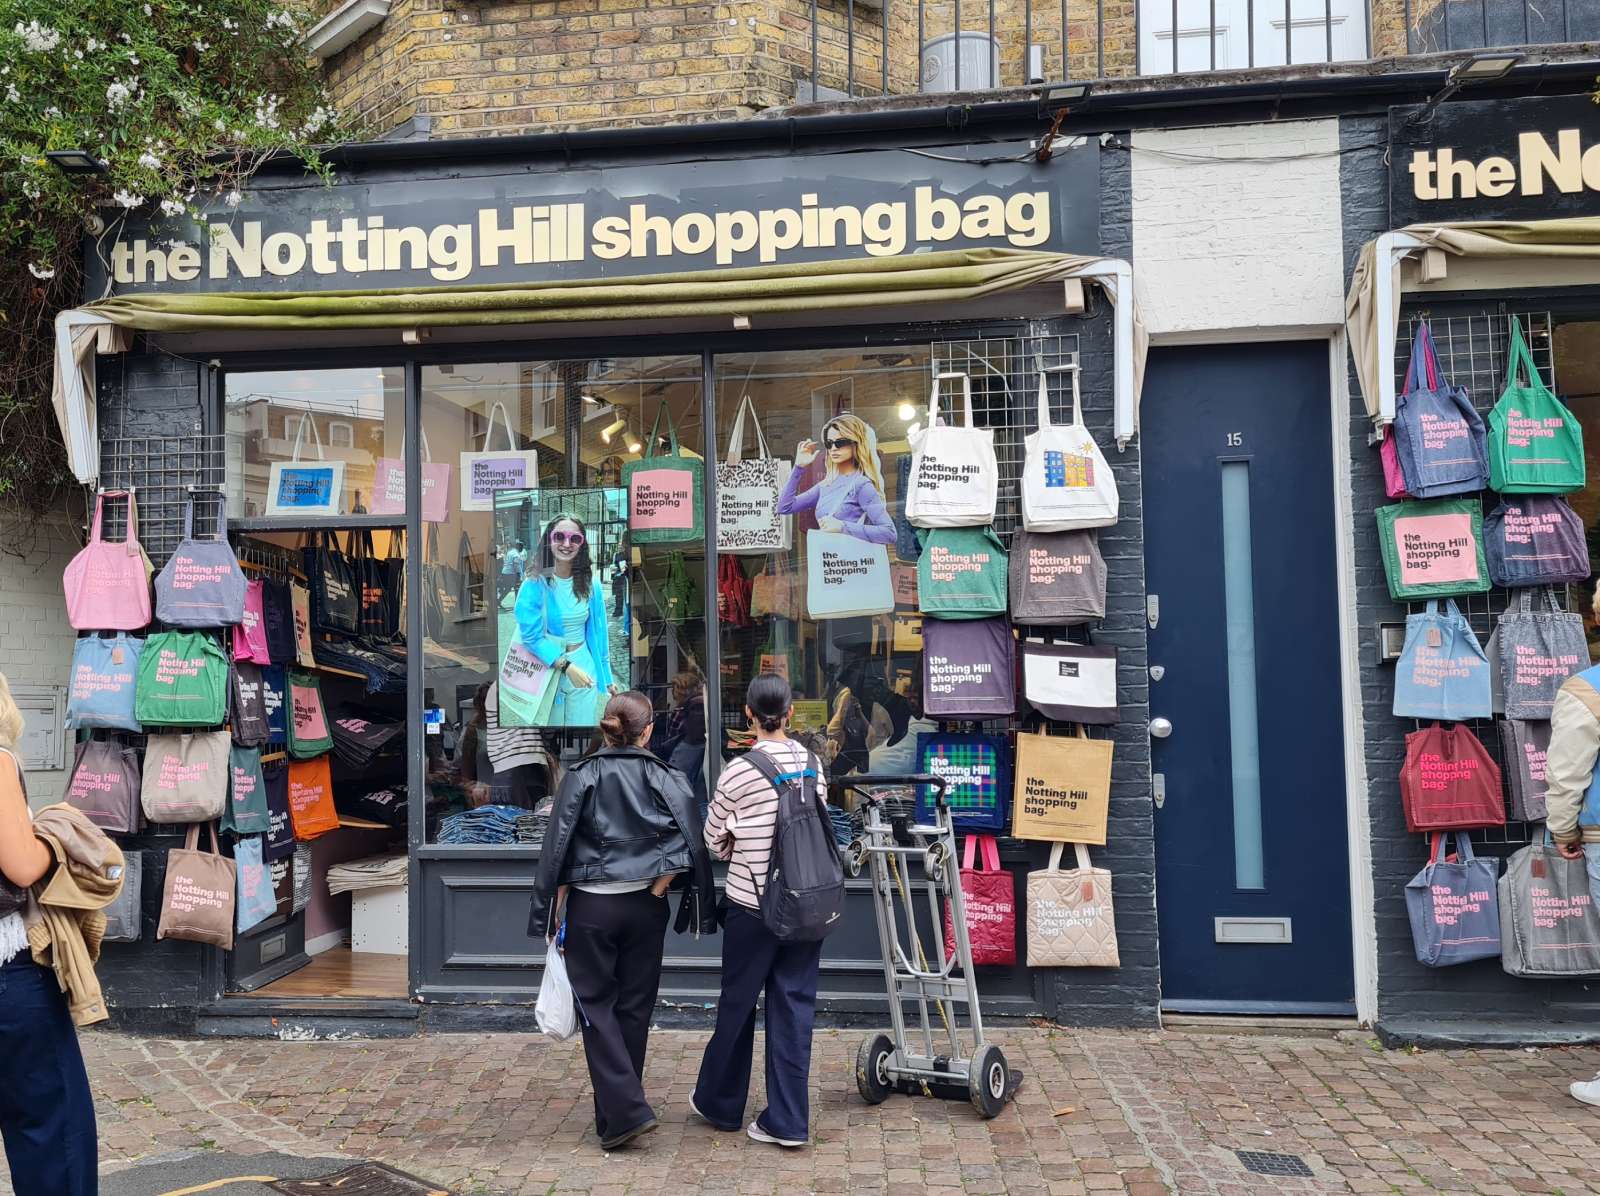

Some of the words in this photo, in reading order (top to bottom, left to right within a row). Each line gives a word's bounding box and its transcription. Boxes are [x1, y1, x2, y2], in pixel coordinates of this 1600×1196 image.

[1409, 149, 1516, 200] the
[111, 239, 200, 284] the
[209, 216, 472, 281] Notting
[479, 203, 585, 267] Hill
[592, 193, 906, 265] shopping
[915, 186, 1050, 247] bag
[1421, 413, 1438, 422] the
[1423, 421, 1460, 431] Notting
[1227, 432, 1242, 446] 15
[474, 463, 489, 471] the
[919, 463, 958, 474] Notting
[962, 464, 980, 474] Hill
[474, 470, 506, 480] Notting
[508, 469, 523, 477] Hill
[918, 472, 969, 483] shopping
[474, 477, 516, 487] shopping
[637, 484, 651, 492] the
[636, 491, 670, 501] Notting
[672, 490, 688, 499] Hill
[722, 493, 736, 501] the
[636, 498, 681, 509] shopping
[721, 500, 753, 510] Notting
[755, 500, 769, 508] Hill
[636, 507, 657, 517] bag.
[721, 508, 762, 518] shopping
[1542, 514, 1561, 523] Hill
[1404, 533, 1421, 542] the
[1405, 541, 1445, 551] Notting
[1449, 538, 1468, 548] Hill
[930, 546, 948, 555] the
[1029, 549, 1048, 557] the
[1406, 549, 1460, 560] shopping
[176, 556, 193, 564] the
[822, 552, 838, 560] the
[930, 553, 970, 564] Notting
[972, 553, 989, 563] Hill
[1029, 556, 1071, 567] Notting
[1072, 555, 1091, 565] Hill
[823, 559, 858, 568] Notting
[860, 558, 875, 566] Hill
[931, 562, 981, 572] shopping
[175, 565, 212, 574] Notting
[823, 566, 868, 576] shopping
[1030, 564, 1083, 575] shopping
[175, 573, 221, 583] shopping
[824, 576, 846, 585] bag.
[1515, 645, 1536, 655] the
[929, 656, 948, 665] the
[1516, 655, 1558, 666] Notting
[1560, 655, 1578, 664] Hill
[929, 664, 970, 675] Notting
[973, 664, 991, 673] Hill
[1516, 664, 1569, 676] shopping
[931, 673, 982, 684] shopping
[931, 683, 955, 693] bag.
[930, 757, 949, 766] the
[1420, 752, 1440, 761] the
[1460, 759, 1479, 769] Hill
[930, 765, 970, 776] Notting
[972, 765, 990, 774] Hill
[1421, 770, 1471, 780] shoppng
[104, 772, 120, 783] Hill
[943, 775, 982, 785] opping
[1026, 777, 1045, 786] the
[930, 784, 955, 794] bg.
[1025, 786, 1067, 800] Notting
[1070, 790, 1088, 800] Hill
[1025, 796, 1077, 809] shopping
[1024, 805, 1048, 816] bag.
[175, 876, 193, 885] the
[174, 884, 213, 899] Notting
[216, 889, 230, 900] Hill
[1431, 885, 1451, 895] the
[1531, 887, 1550, 896] the
[172, 893, 222, 908] shopping
[1469, 891, 1489, 902] Hill
[1571, 895, 1590, 905] Hill
[1434, 902, 1480, 915] shoping
[964, 910, 1003, 922] hopping
